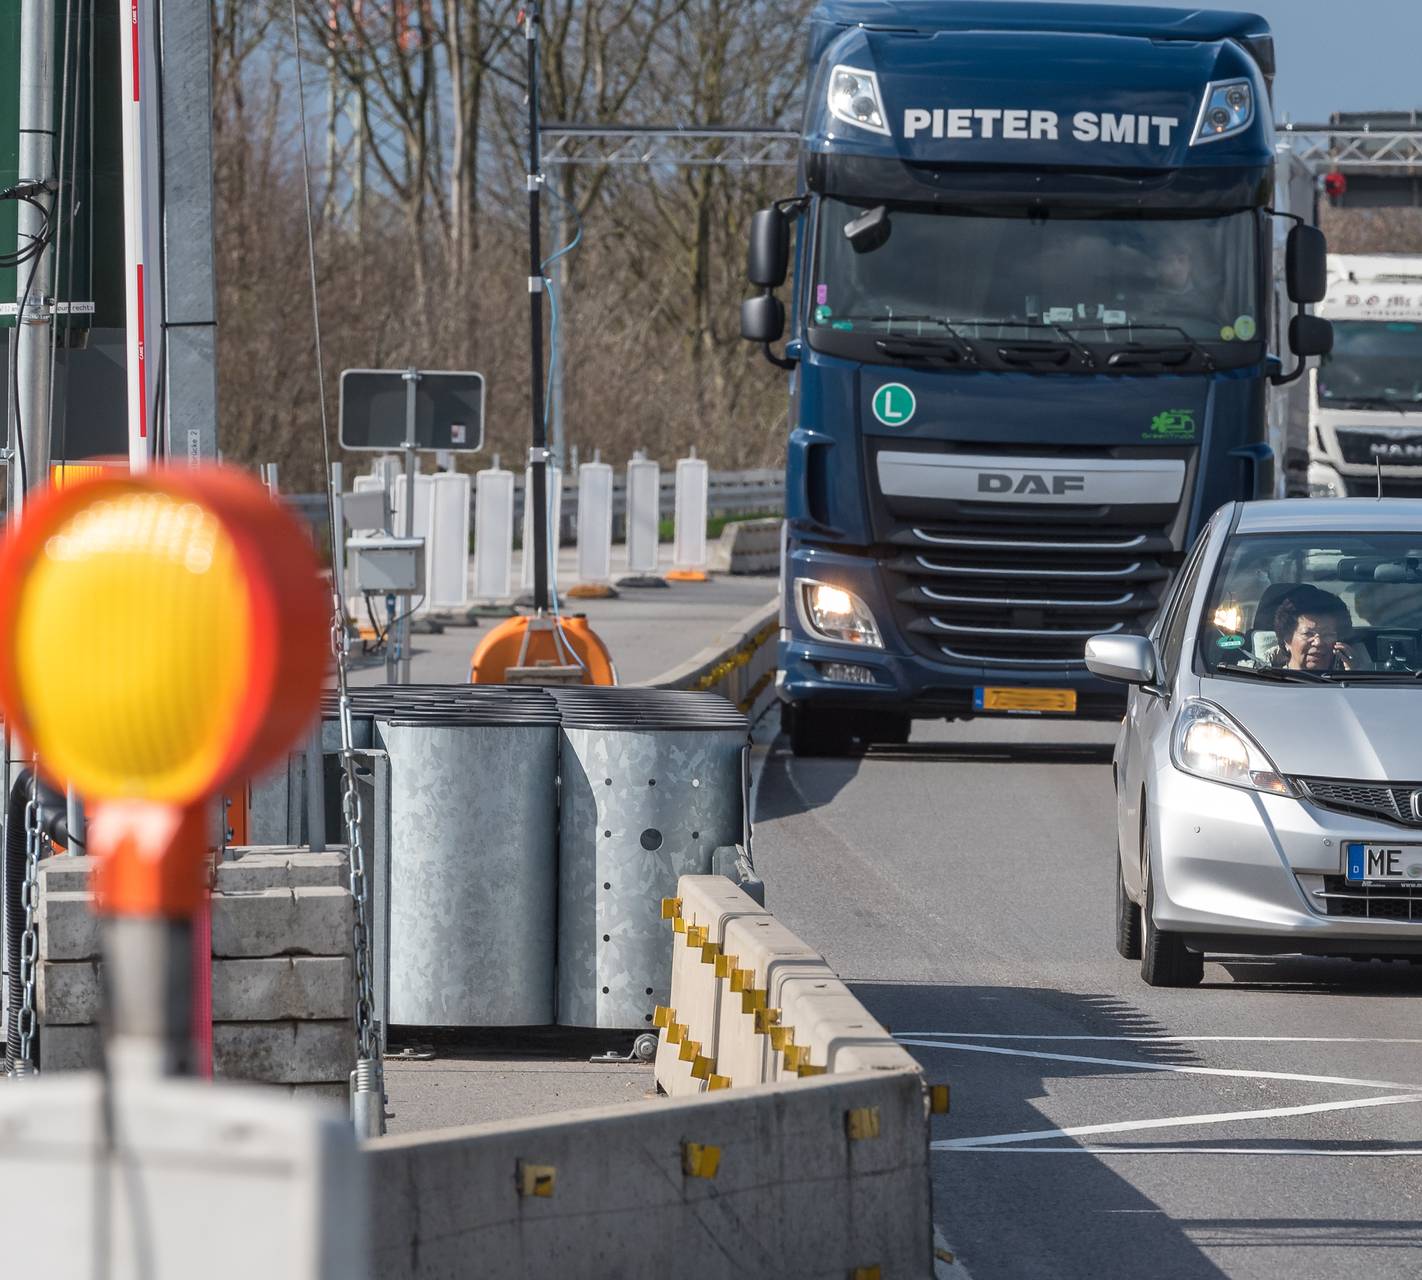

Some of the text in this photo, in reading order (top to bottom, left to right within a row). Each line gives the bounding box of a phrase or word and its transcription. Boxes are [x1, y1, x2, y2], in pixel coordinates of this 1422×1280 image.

[904, 109, 1178, 146] PIETER SMIT
[885, 391, 902, 417] L
[978, 473, 1084, 495] DAF
[1367, 849, 1403, 876] ME
